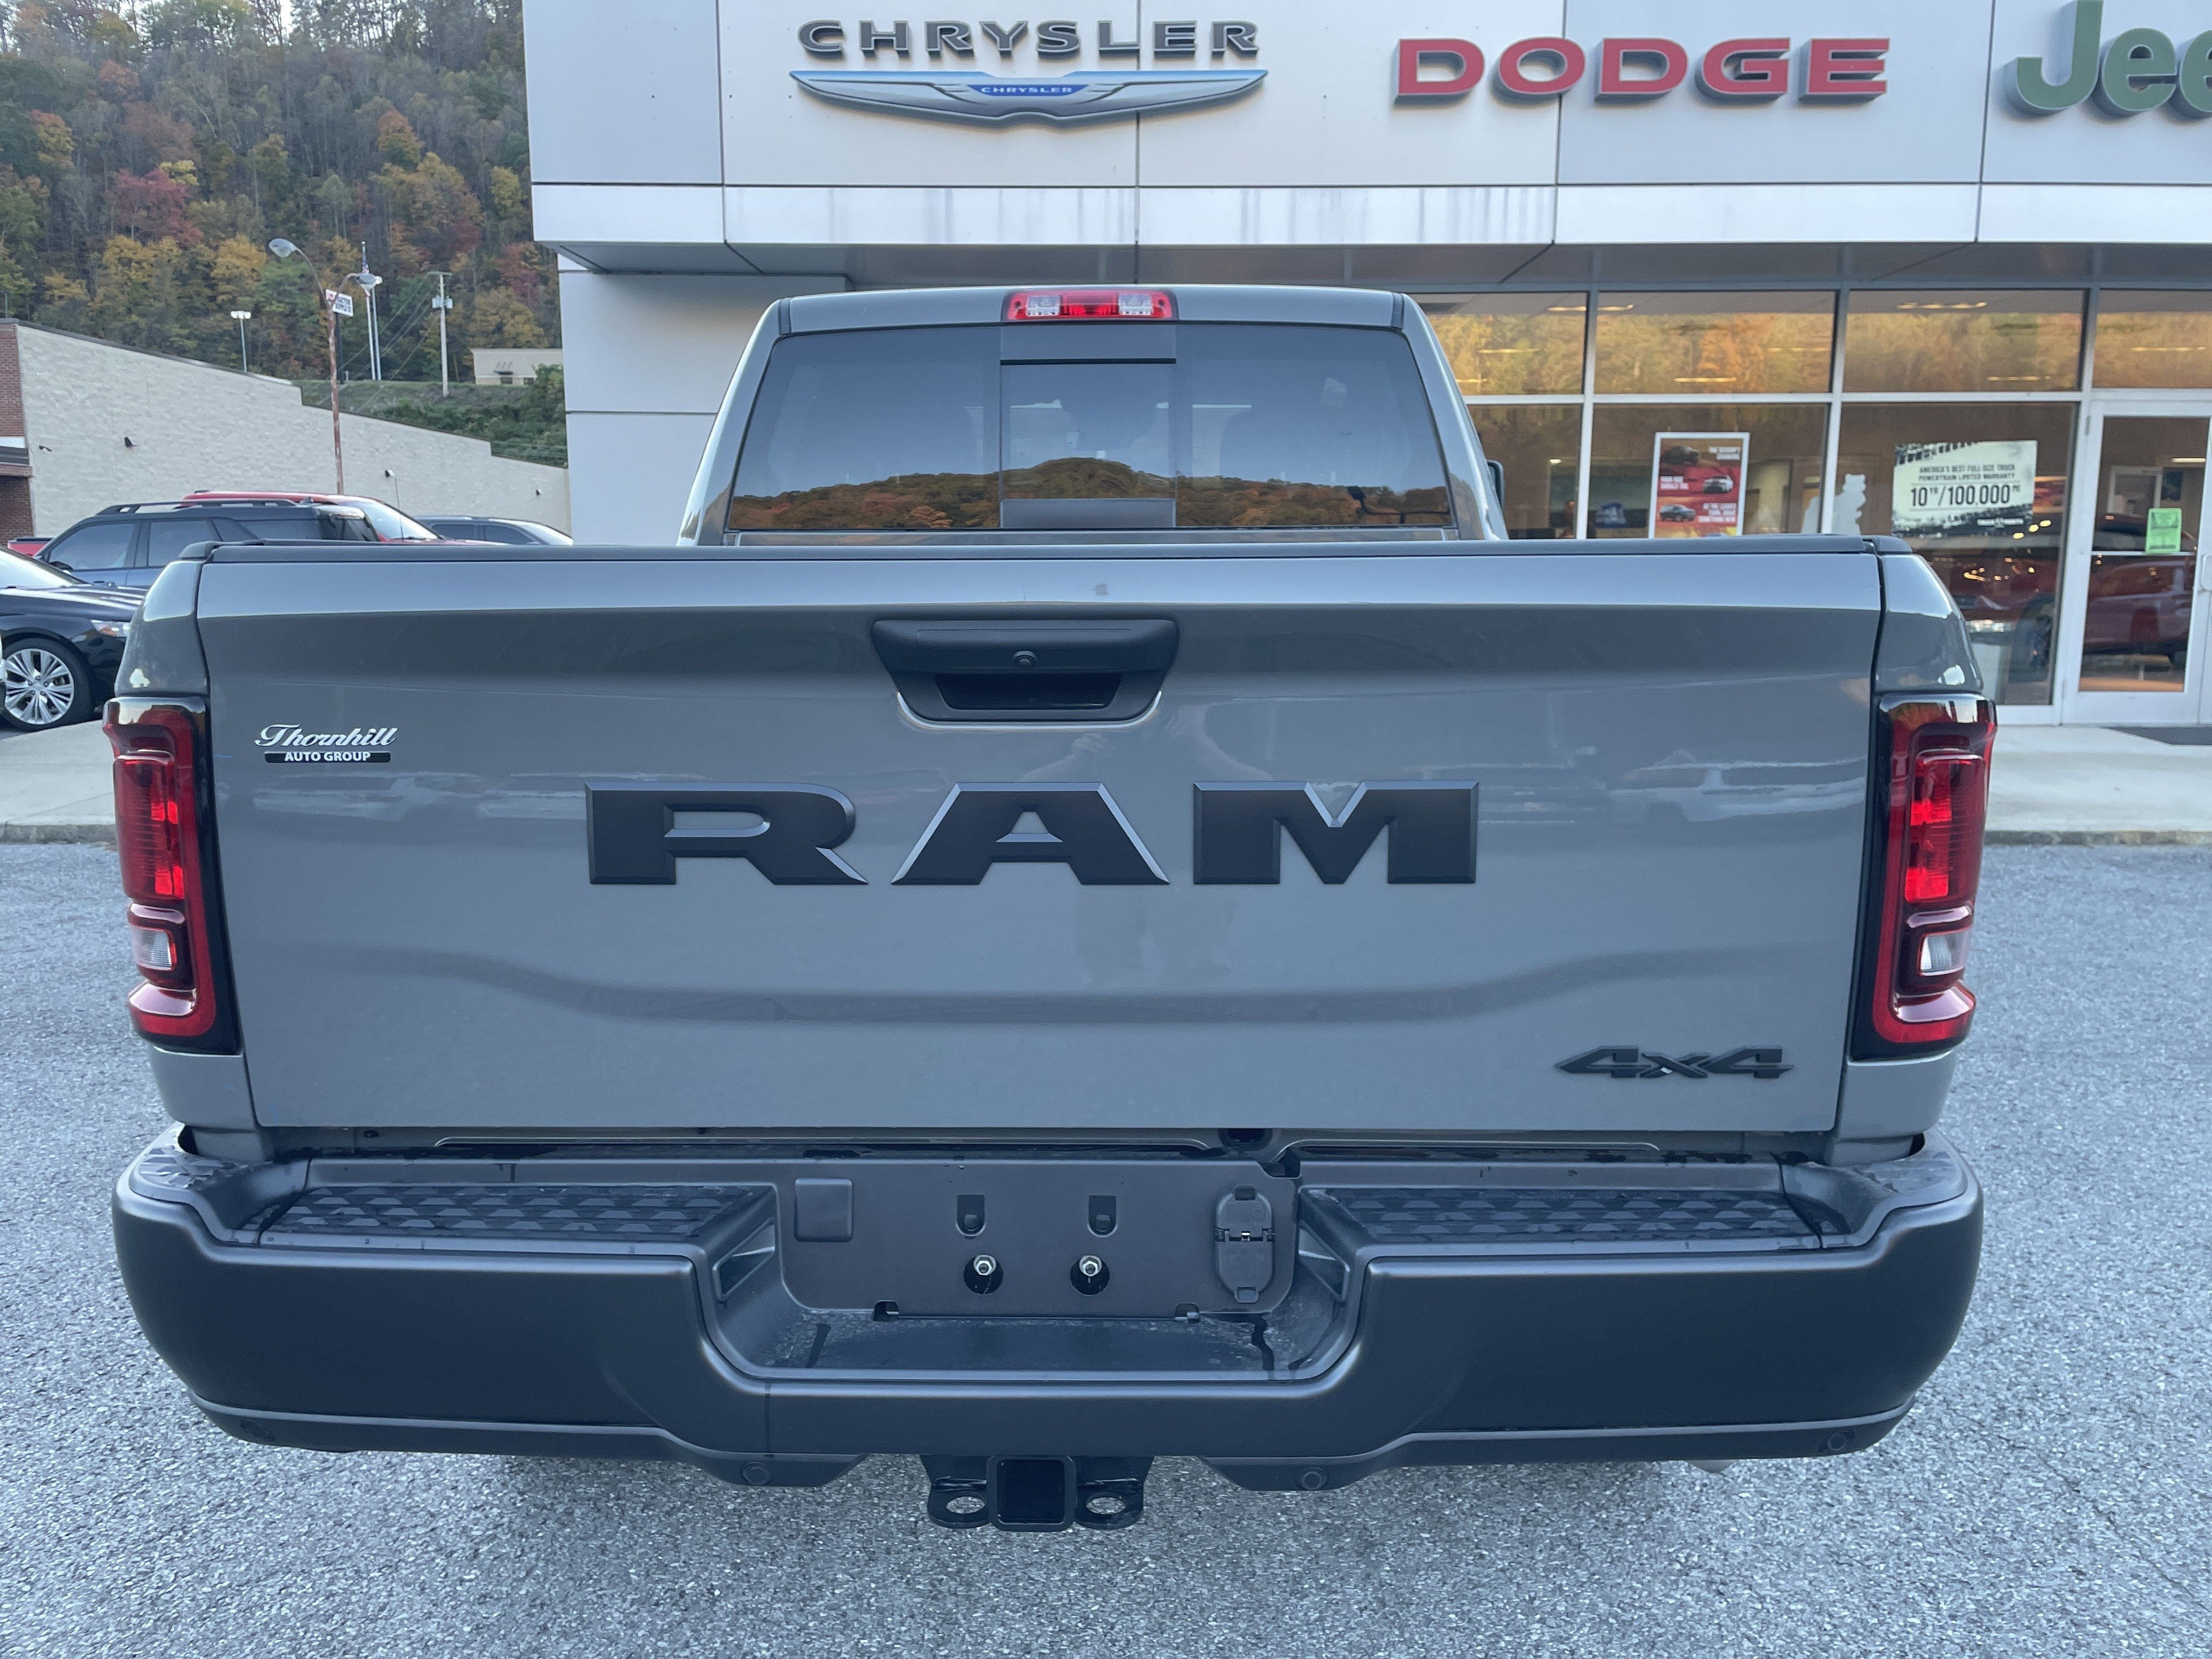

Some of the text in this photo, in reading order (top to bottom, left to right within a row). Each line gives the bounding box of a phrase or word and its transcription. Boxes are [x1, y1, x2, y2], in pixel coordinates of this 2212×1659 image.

[797, 19, 1260, 57] CHRYSLER
[1396, 37, 1891, 99] DODGE
[254, 724, 399, 747] Thornhill
[284, 752, 371, 761] AUTO GROUP
[584, 781, 1480, 886] RAM
